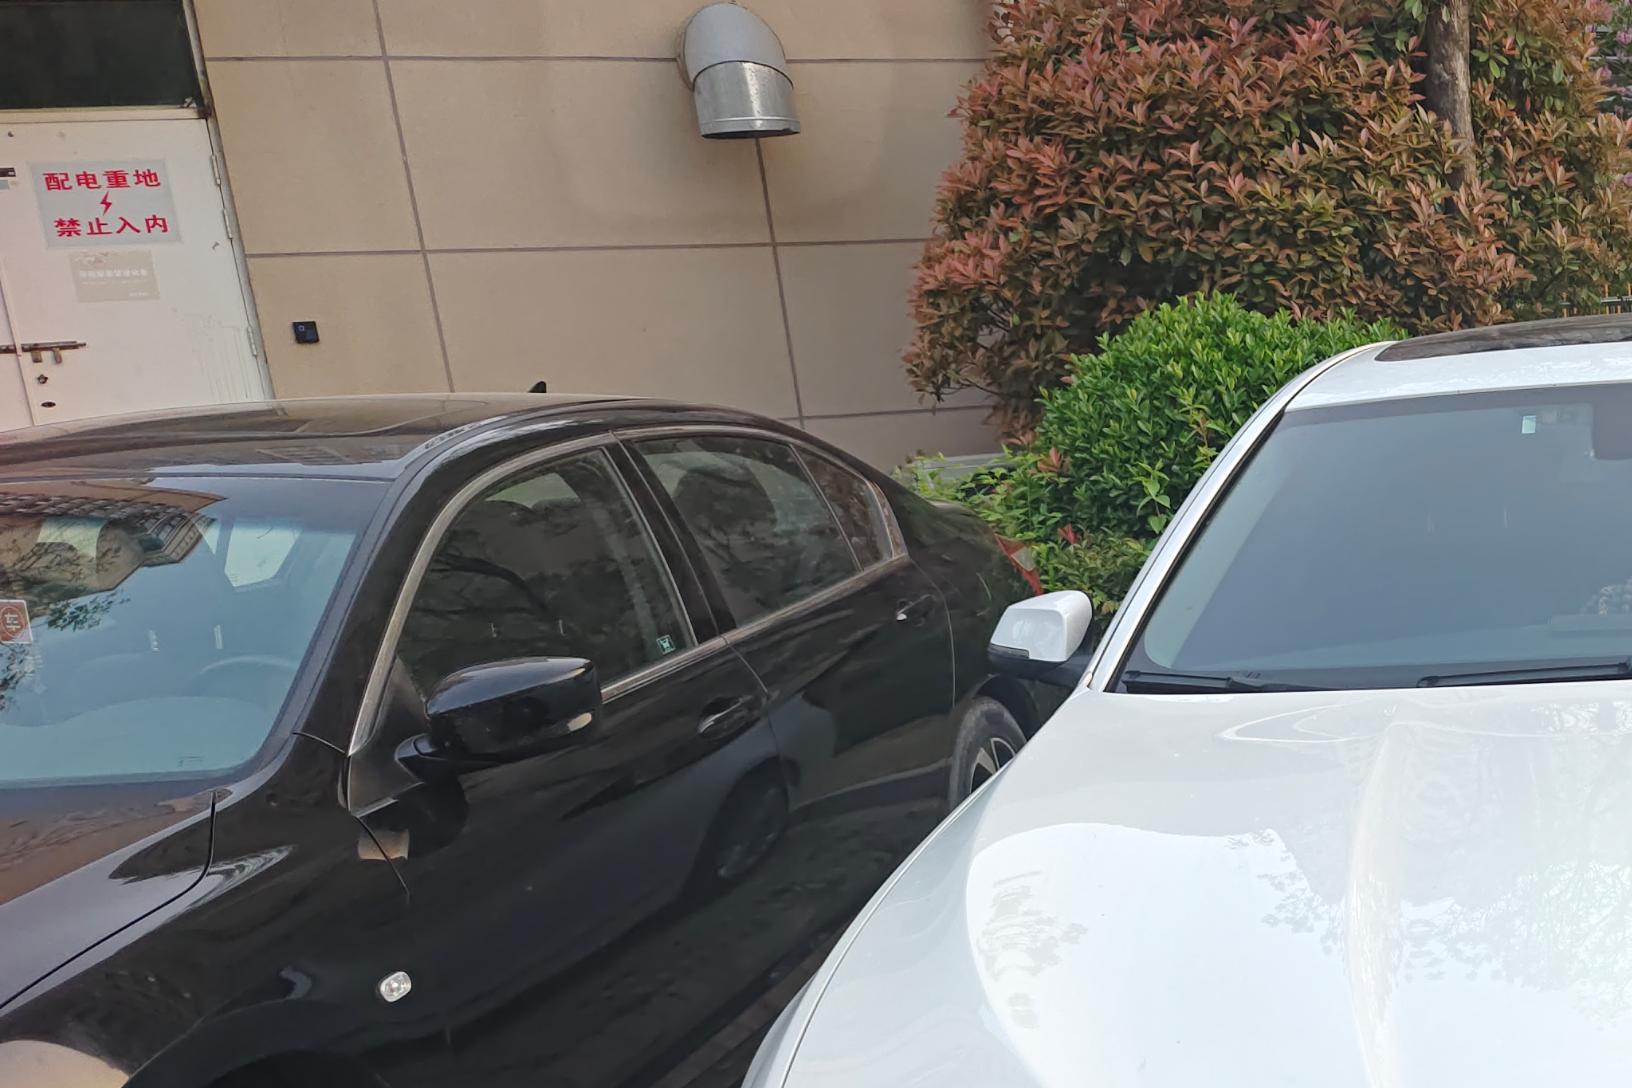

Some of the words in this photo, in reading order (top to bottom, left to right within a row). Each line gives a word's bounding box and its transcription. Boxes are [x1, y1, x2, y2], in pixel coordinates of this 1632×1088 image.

[43, 169, 161, 191] 配电重地
[54, 214, 169, 238] 禁止入内
